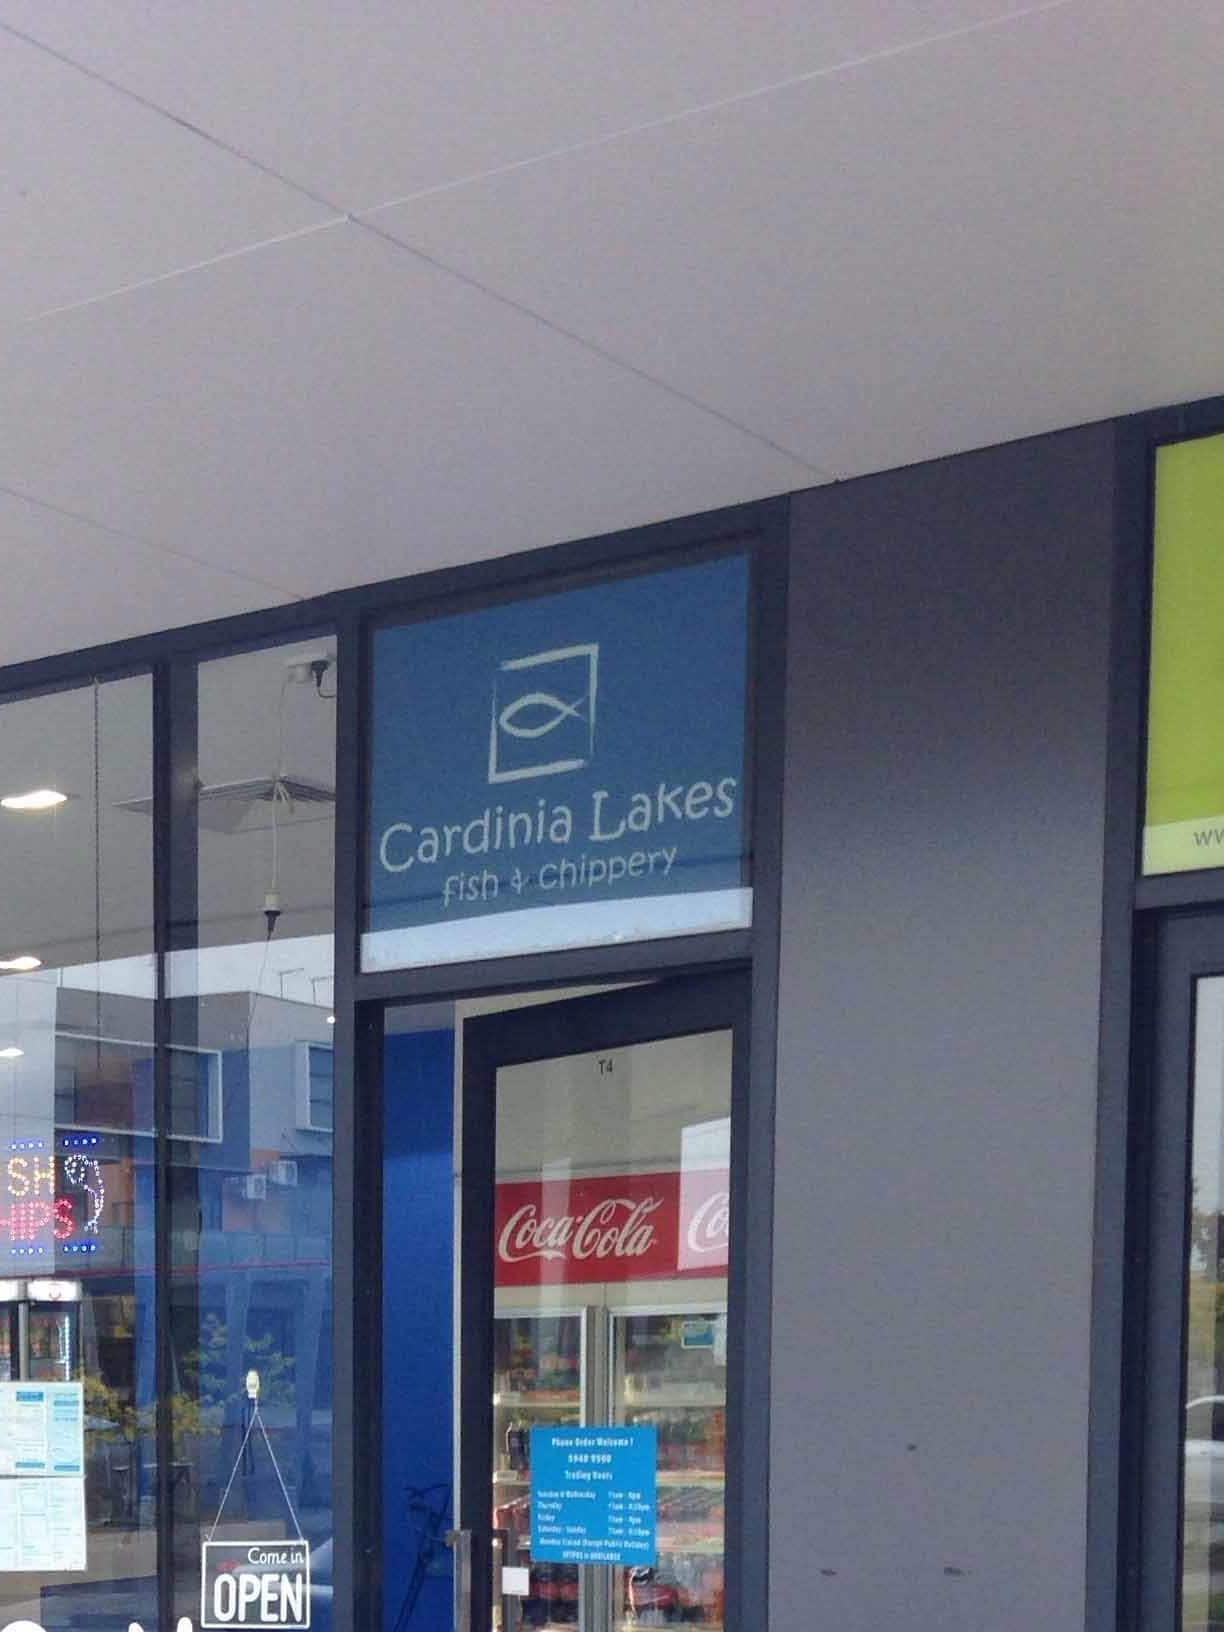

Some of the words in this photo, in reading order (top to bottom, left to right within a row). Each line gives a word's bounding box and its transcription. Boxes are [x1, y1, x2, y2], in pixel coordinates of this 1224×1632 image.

[379, 799, 573, 872] Cardinia
[589, 777, 737, 841] Lakes
[443, 869, 499, 907] fish
[539, 846, 677, 890] chippery
[247, 1546, 287, 1566] Come
[290, 1547, 305, 1565] in
[214, 1572, 303, 1624] OPEN
